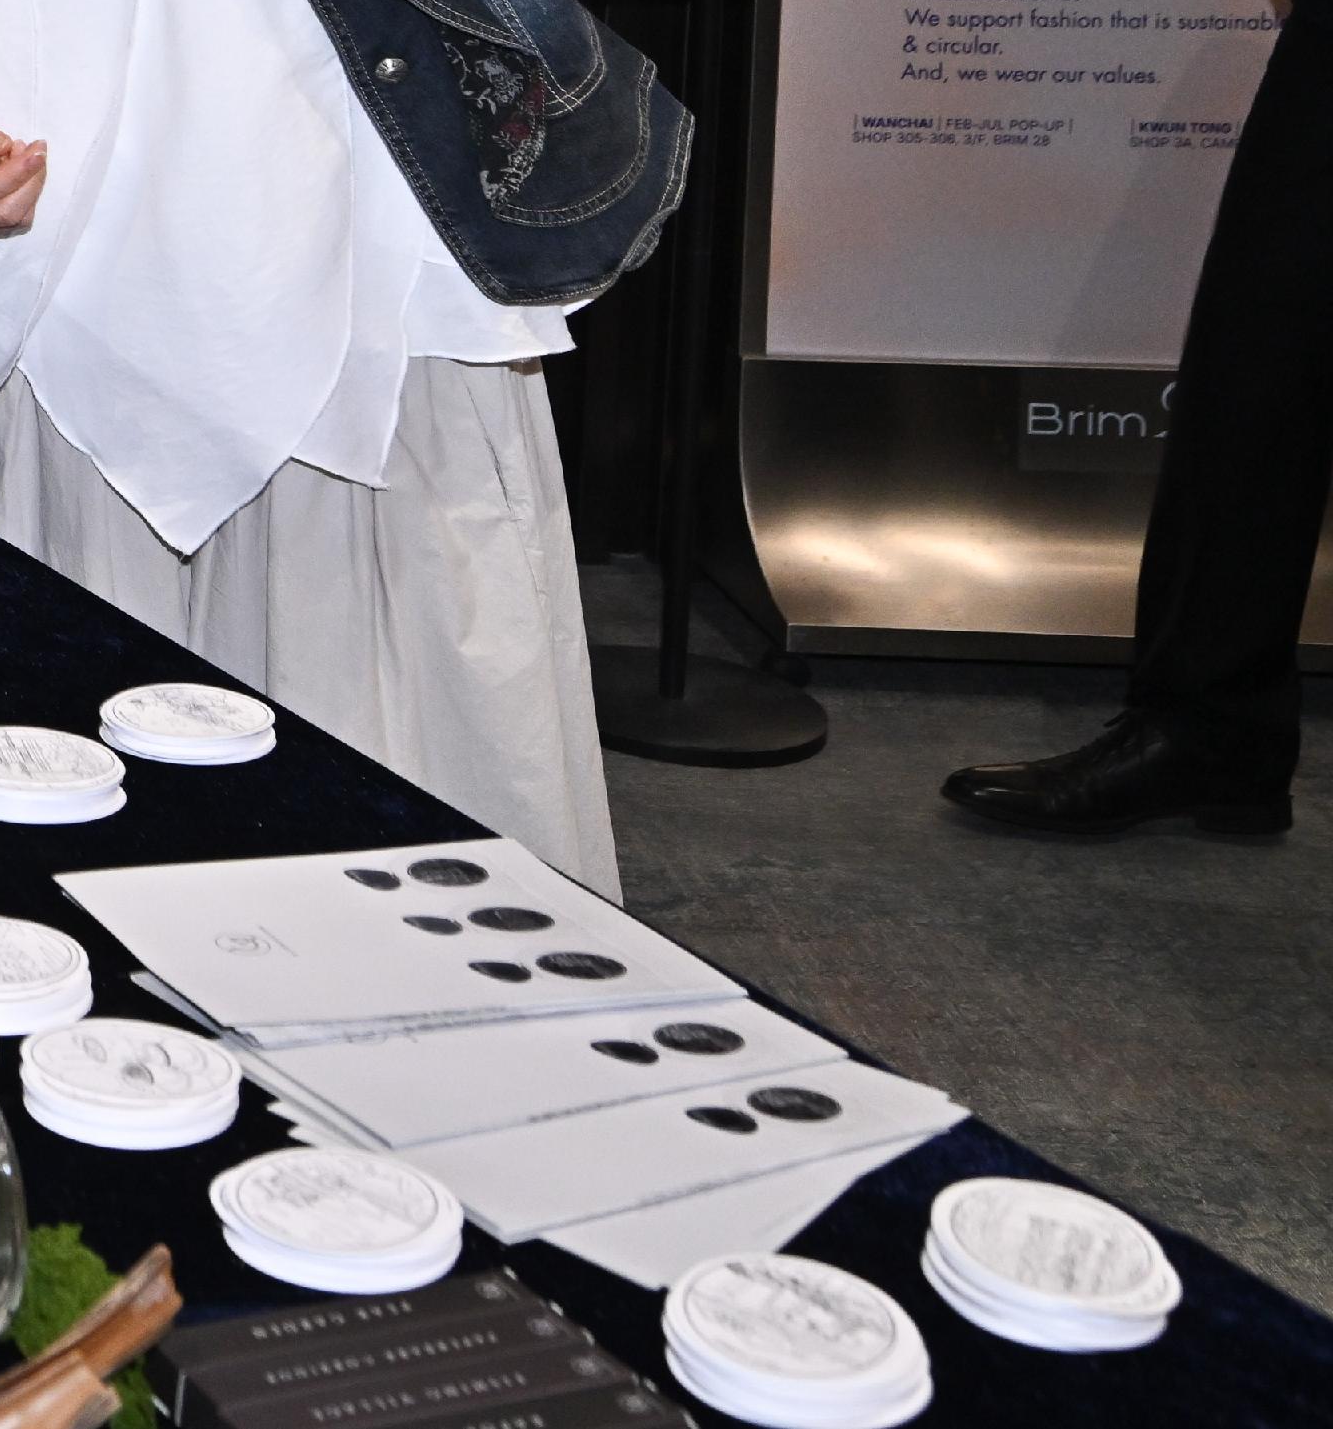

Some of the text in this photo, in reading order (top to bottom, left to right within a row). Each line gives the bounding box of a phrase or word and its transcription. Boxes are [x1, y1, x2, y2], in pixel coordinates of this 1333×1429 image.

[904, 9, 940, 28] We
[947, 10, 1023, 32] support
[1030, 9, 1103, 29] fashion
[1110, 10, 1148, 30] that
[1155, 12, 1170, 30] is
[902, 35, 1003, 55] & circular.
[900, 63, 1162, 85] And, we wear our values.
[862, 116, 933, 129] WANCHAI
[1009, 119, 1065, 132] POP-UP
[1139, 122, 1231, 134] KWUN TONG
[852, 131, 892, 143] SHOP
[993, 134, 1029, 146] BRIM
[1033, 134, 1051, 147] 28
[1130, 136, 1169, 148] SHOP
[1026, 403, 1147, 438] Brim
